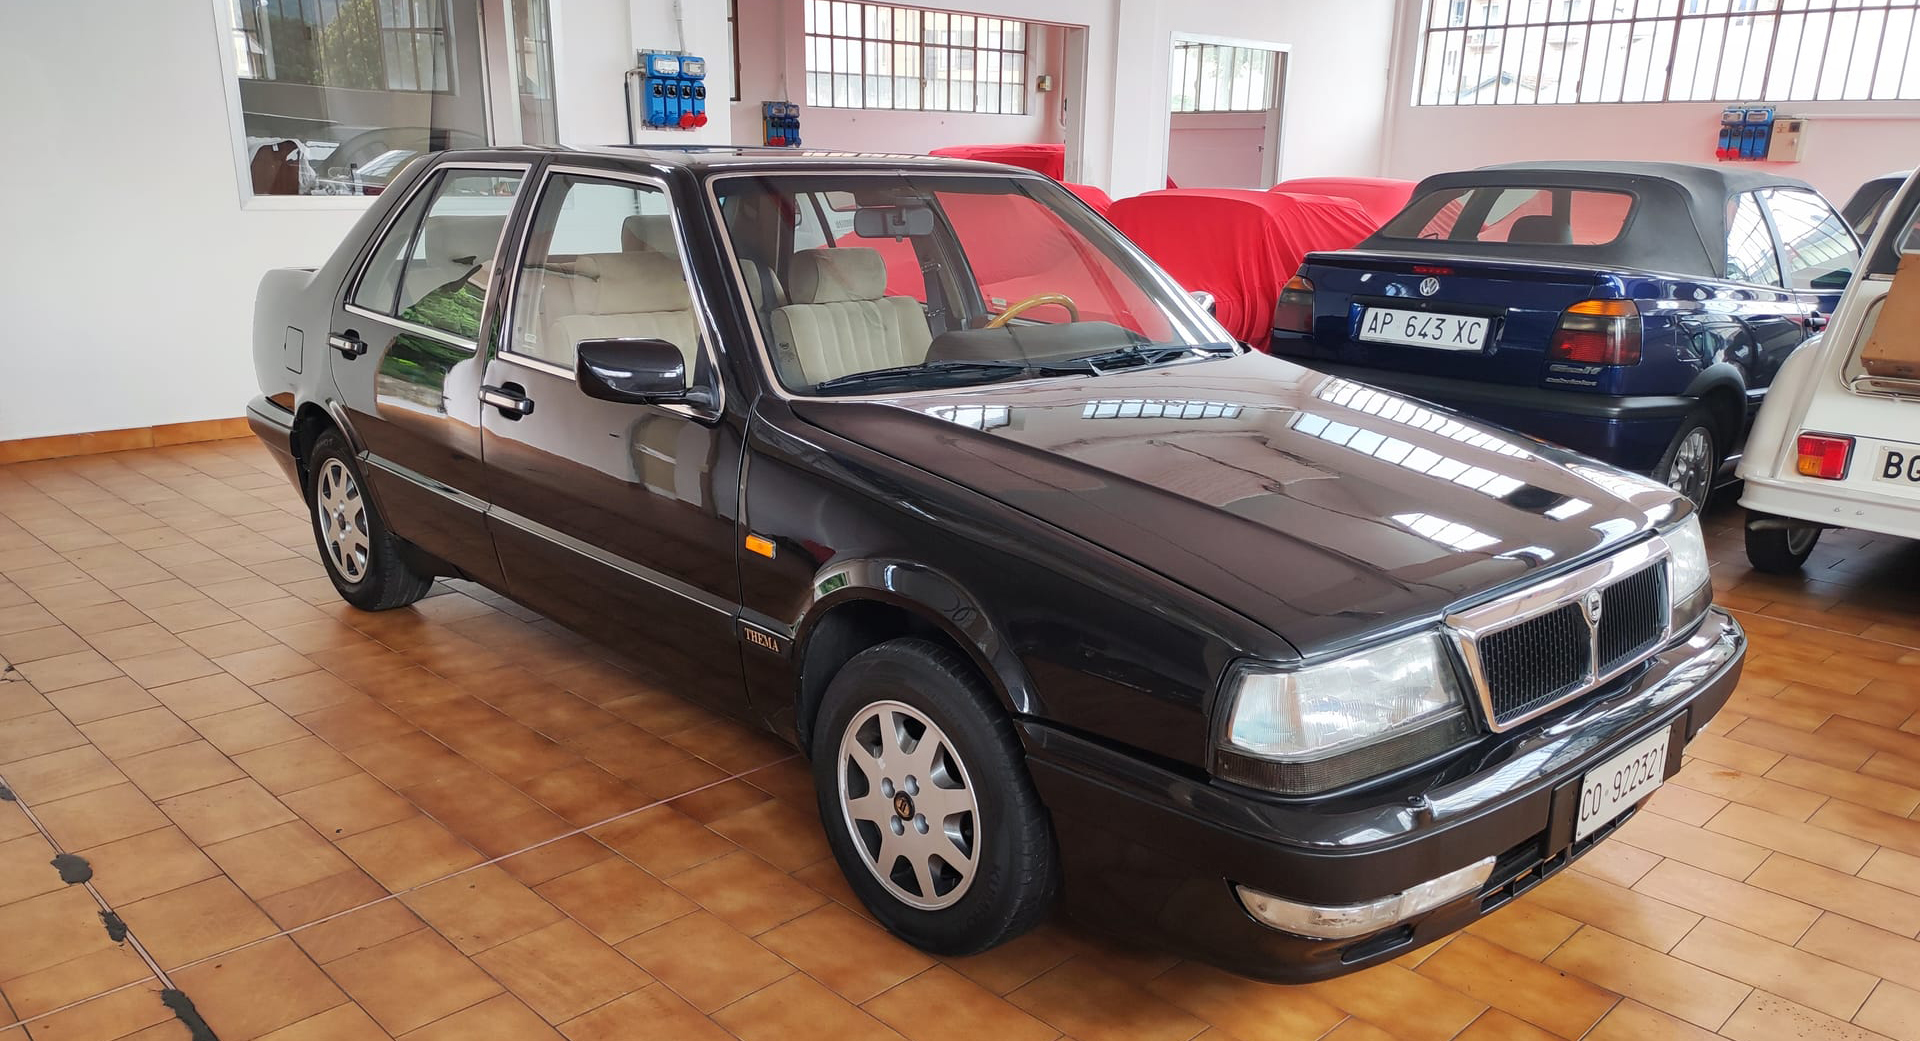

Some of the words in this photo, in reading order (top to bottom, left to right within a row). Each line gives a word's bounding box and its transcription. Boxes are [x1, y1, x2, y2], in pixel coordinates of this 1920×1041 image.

[1367, 311, 1394, 335] AP
[1403, 315, 1445, 341] 643
[1452, 320, 1482, 345] XC
[744, 627, 780, 652] THEMA
[1581, 782, 1602, 822] CO
[1612, 743, 1665, 803] 922321
